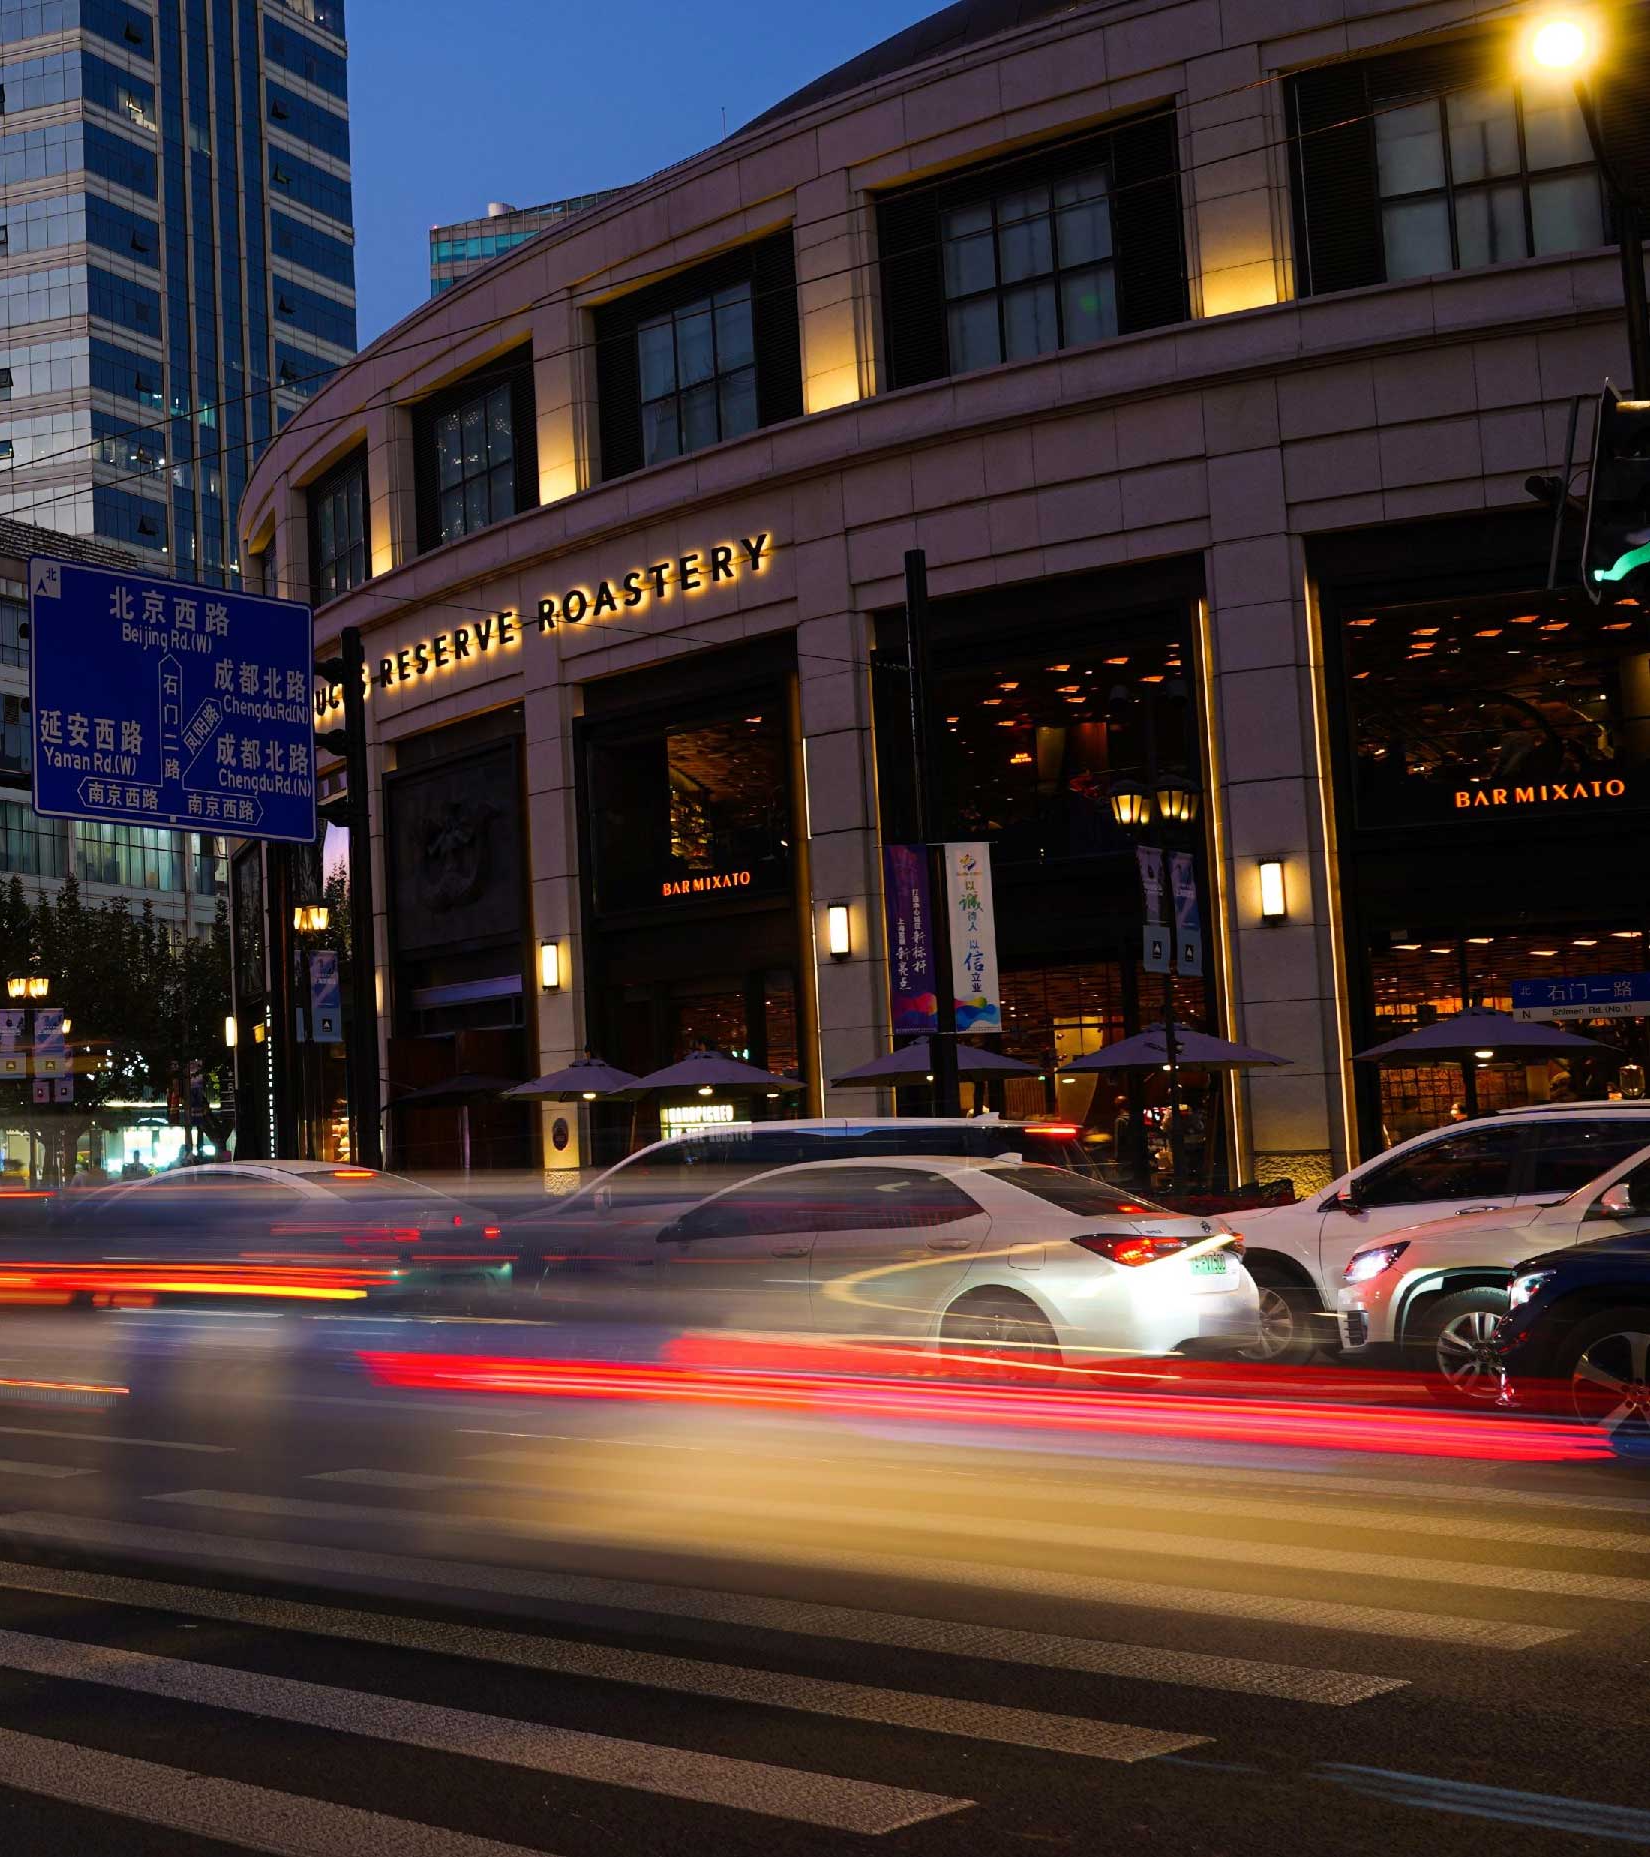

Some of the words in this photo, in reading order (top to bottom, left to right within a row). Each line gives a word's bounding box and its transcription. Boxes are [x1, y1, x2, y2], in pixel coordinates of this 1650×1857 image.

[46, 567, 57, 581] 北
[109, 586, 230, 637] 北京西路
[379, 610, 516, 689] RESERVE
[537, 533, 770, 633] ROASTERY
[122, 622, 168, 653] Beijing
[214, 658, 307, 704] 成都北路
[40, 709, 143, 756] 延安西路
[162, 674, 180, 780] 石门二路
[183, 702, 220, 755] 凤阳路
[216, 733, 309, 777] 成都北路
[88, 782, 159, 810] 南京西路
[187, 793, 255, 822] 南京西路
[1455, 788, 1508, 808] BAR
[1515, 779, 1626, 804] MIXATO
[661, 879, 691, 897] BAR
[692, 870, 752, 893] MIXATO
[1546, 980, 1632, 1001] 石门一路
[1522, 1010, 1531, 1019] N
[1552, 1007, 1584, 1017] Shimen
